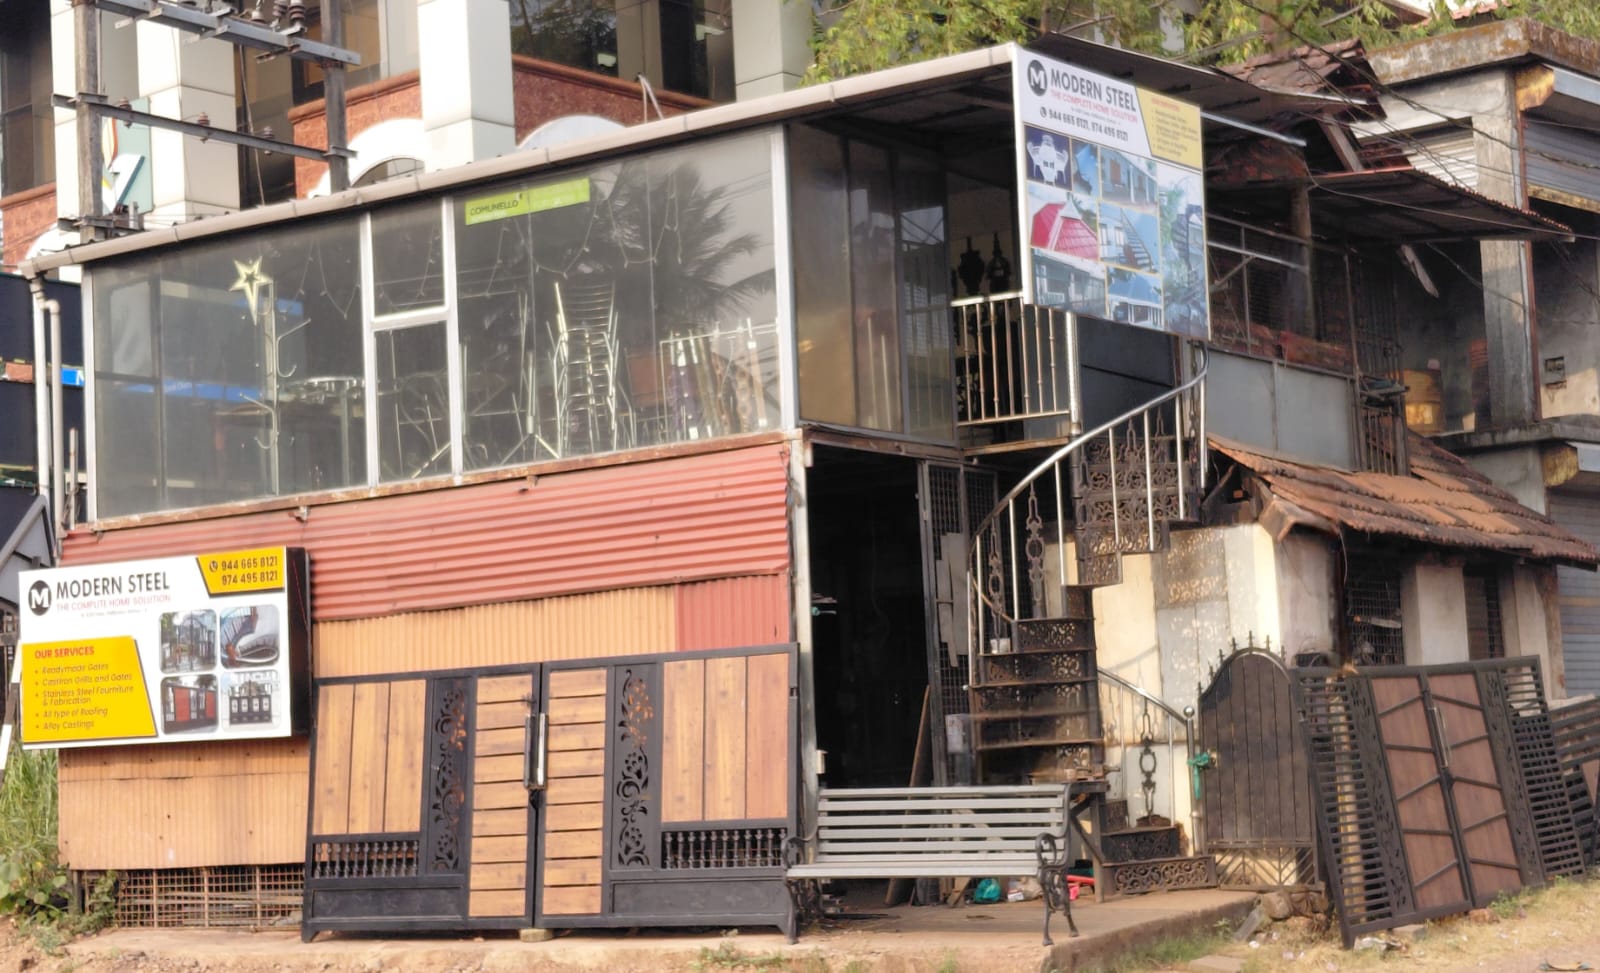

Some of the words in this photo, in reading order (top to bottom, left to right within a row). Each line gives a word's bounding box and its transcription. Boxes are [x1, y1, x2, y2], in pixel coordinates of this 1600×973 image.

[1051, 68, 1102, 101] MODERN
[1106, 86, 1136, 112] STEEL
[221, 560, 239, 571] 944
[241, 558, 258, 569] 665
[260, 556, 278, 567] 8121
[222, 573, 238, 586] 974
[240, 571, 258, 584] 495
[260, 570, 278, 582] 8121
[56, 576, 122, 600] MODERN
[128, 571, 170, 593] STEEL
[109, 597, 130, 608] HOME
[35, 650, 52, 659] OUR
[54, 646, 95, 658] SERVICES
[88, 663, 109, 672] Gates
[94, 673, 109, 682] and
[111, 672, 133, 681] Gates
[77, 687, 95, 696] Steel
